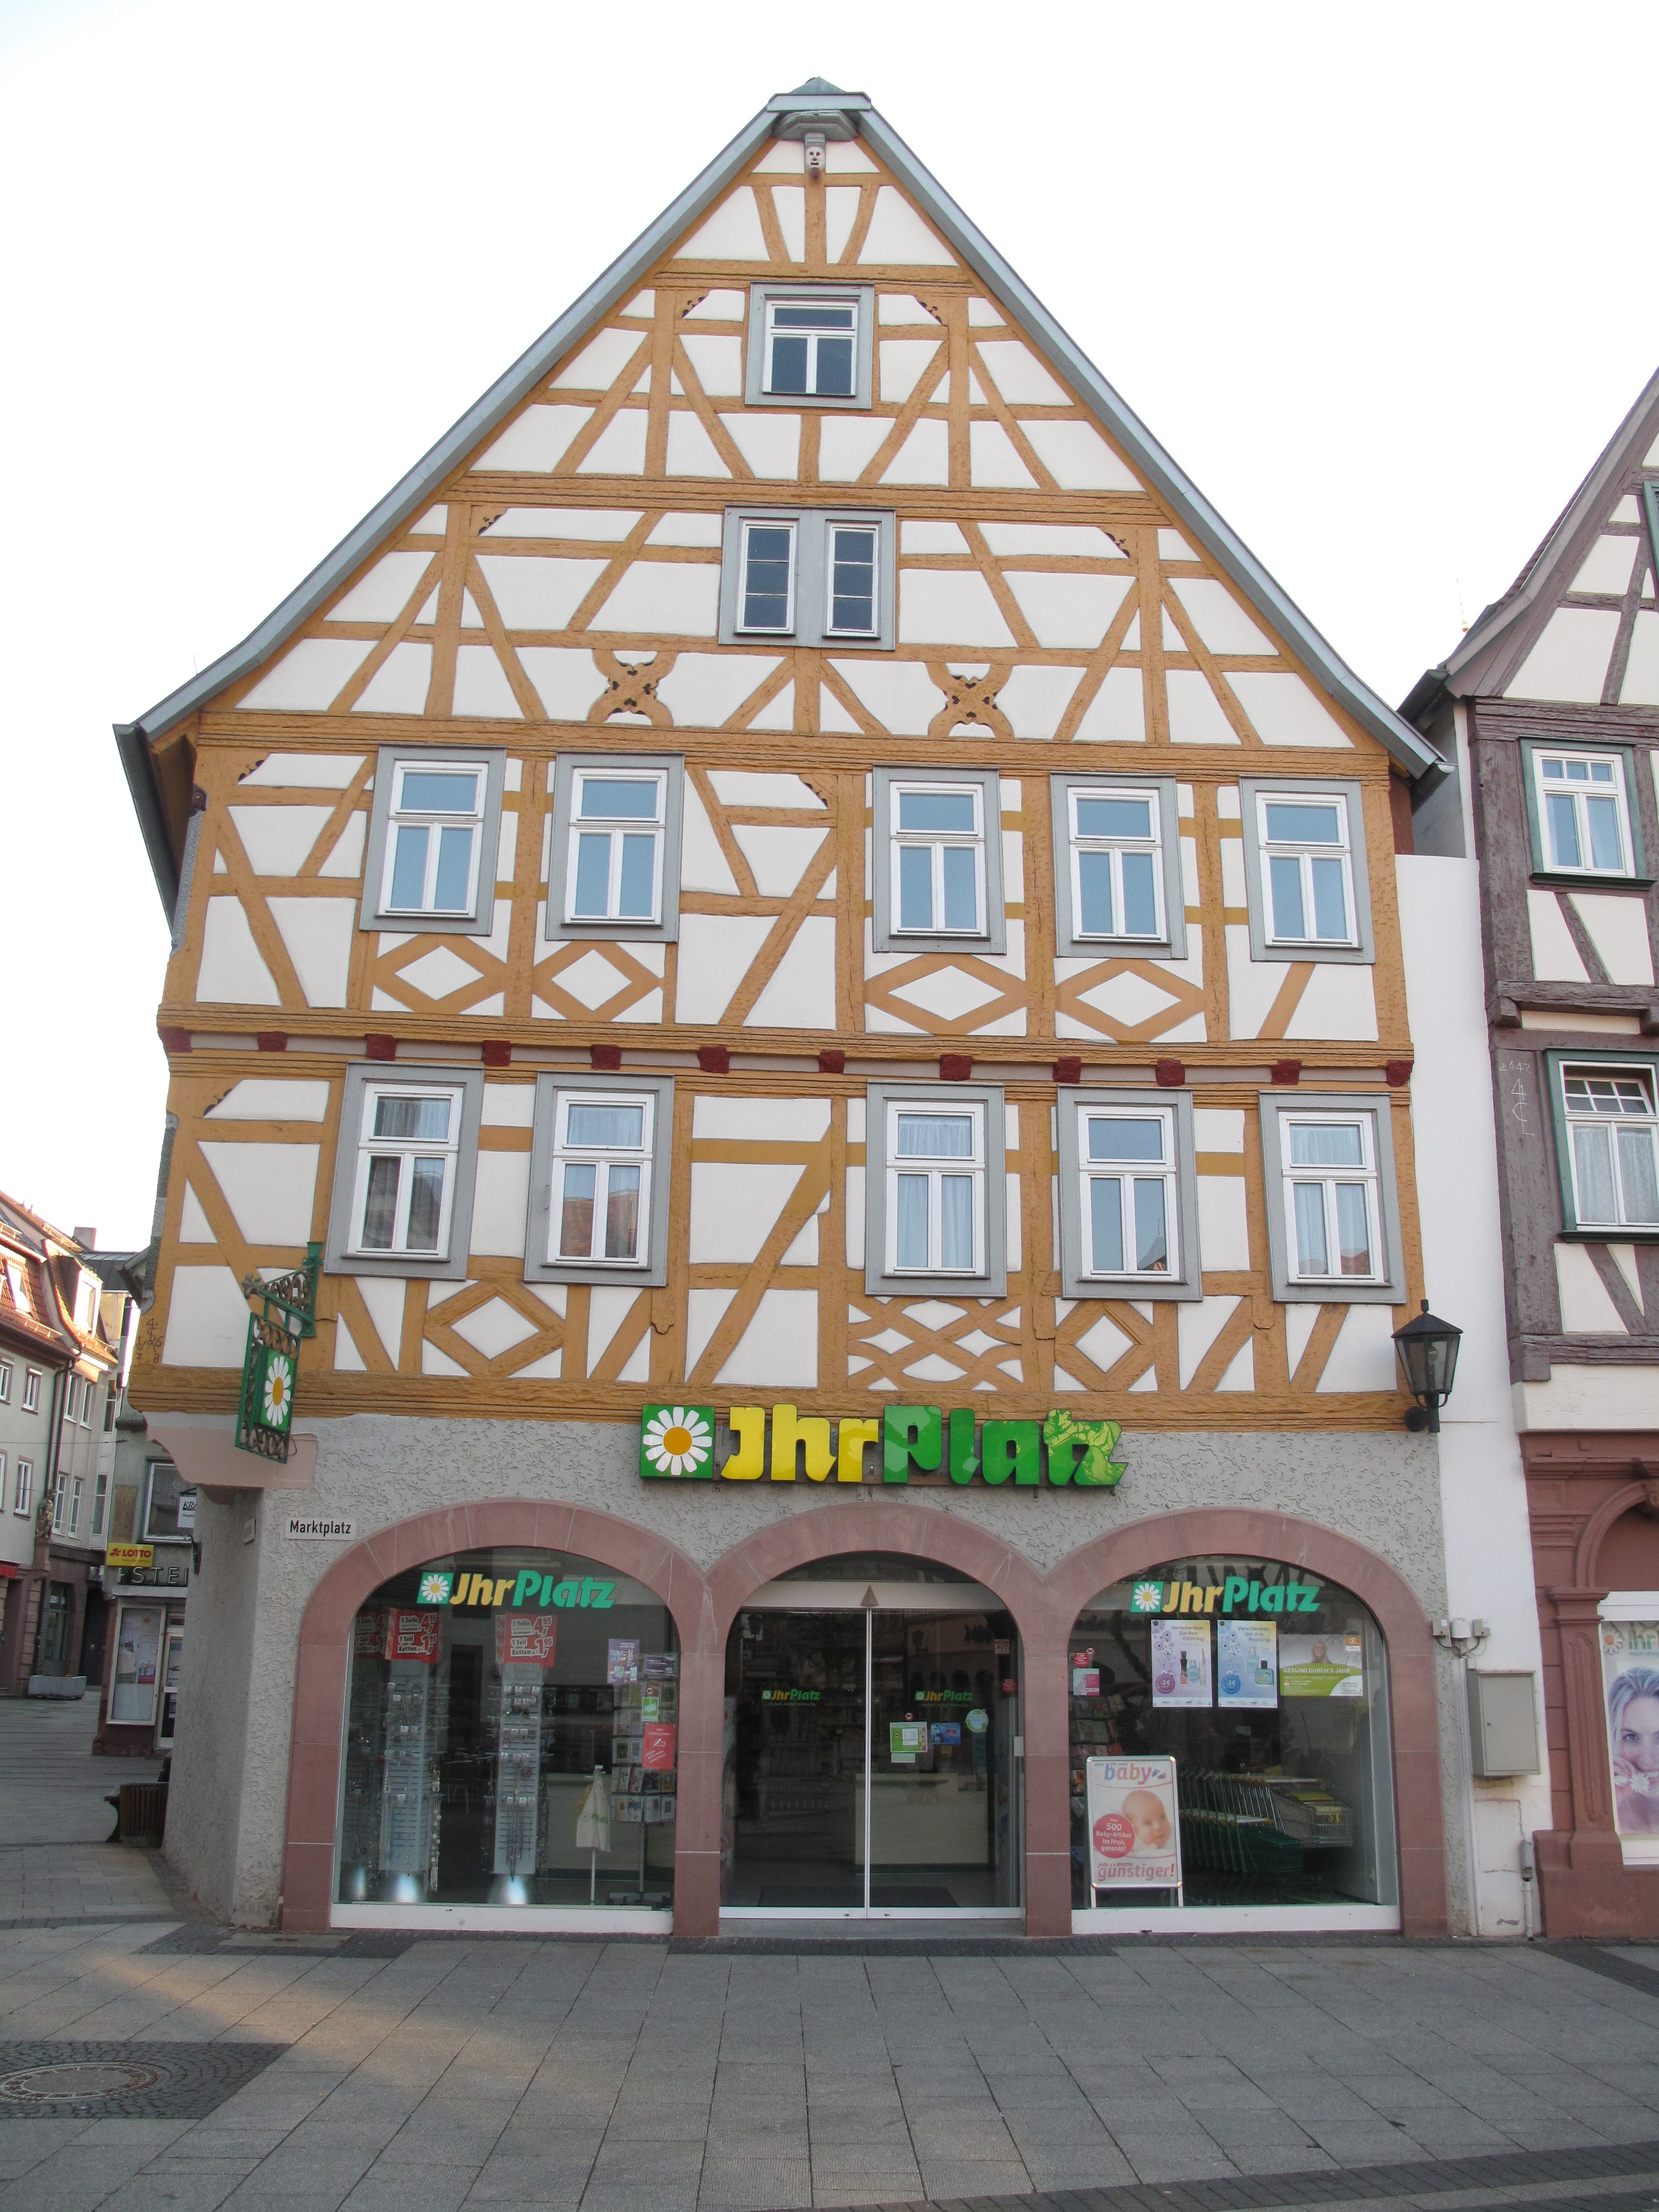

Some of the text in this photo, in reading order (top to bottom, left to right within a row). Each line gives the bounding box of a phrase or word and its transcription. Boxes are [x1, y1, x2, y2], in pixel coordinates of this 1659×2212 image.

[290, 1520, 351, 1537] Marktplatz
[123, 1549, 152, 1557] LOTTO
[1104, 1763, 1152, 1785] baby
[1098, 1863, 1174, 1881] günstiger!
